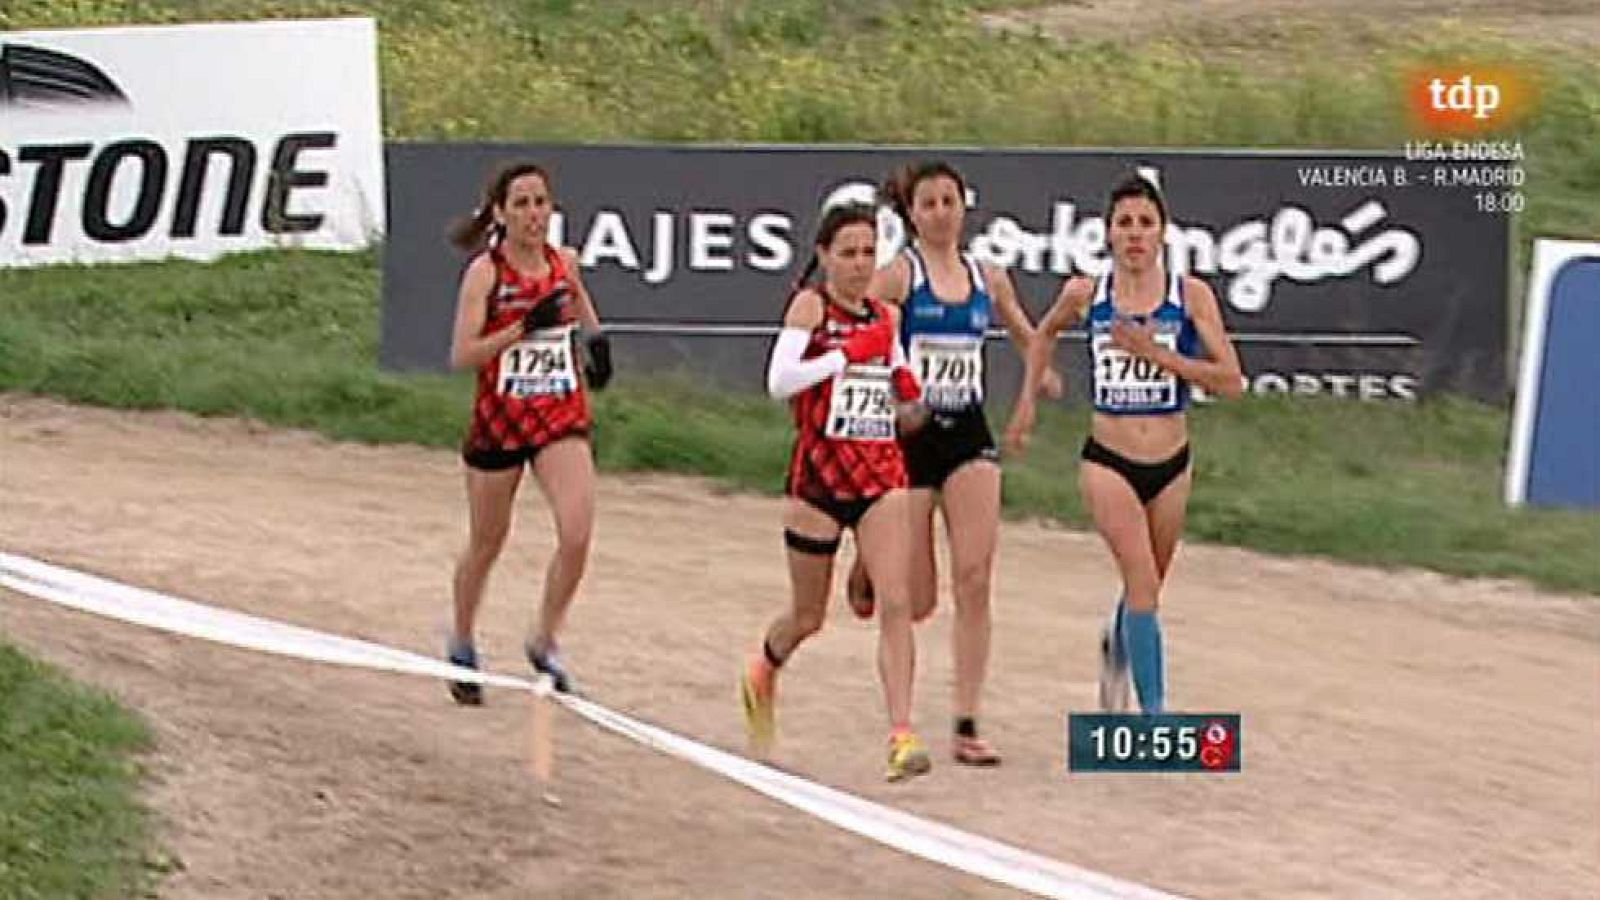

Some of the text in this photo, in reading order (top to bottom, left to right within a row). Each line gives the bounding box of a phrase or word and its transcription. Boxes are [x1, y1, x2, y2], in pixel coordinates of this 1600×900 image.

[0, 132, 337, 246] TONE
[474, 209, 793, 283] IAJES
[1137, 167, 1421, 312] nglés
[508, 346, 566, 374] 1794
[919, 356, 976, 382] 1701
[842, 385, 892, 414] 179
